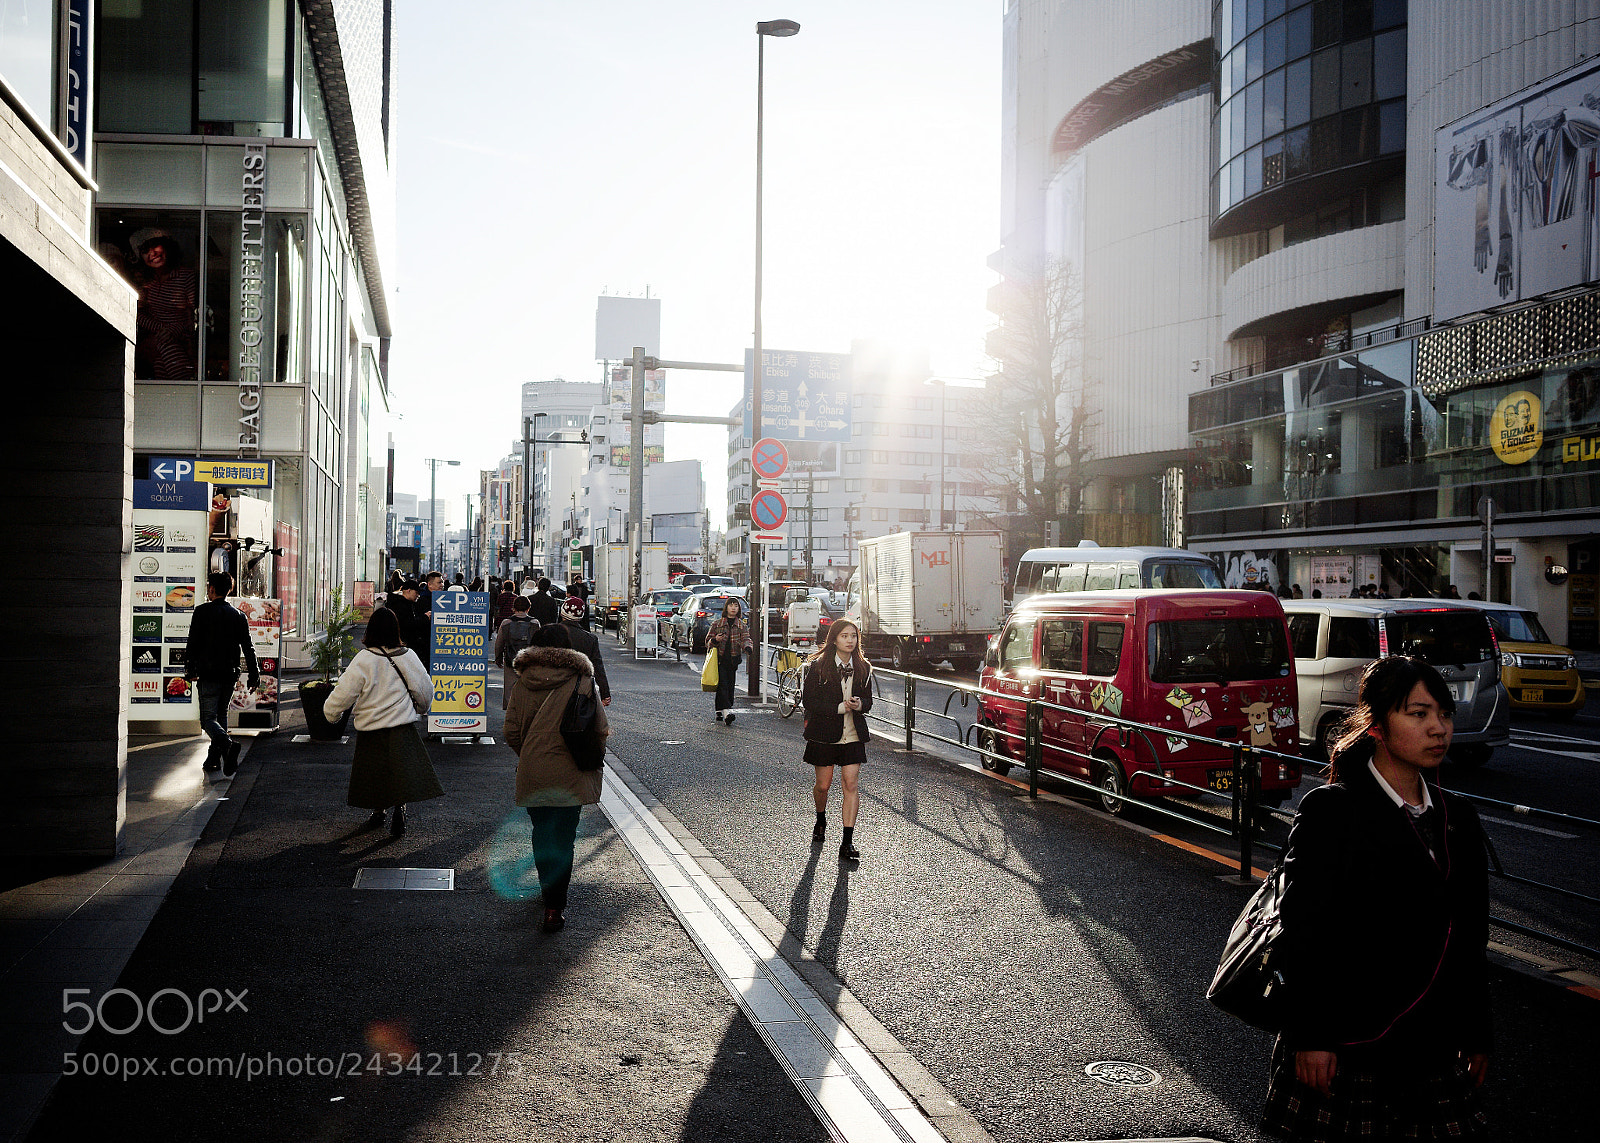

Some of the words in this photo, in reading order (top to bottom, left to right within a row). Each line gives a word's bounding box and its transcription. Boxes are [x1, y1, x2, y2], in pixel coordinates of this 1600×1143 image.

[1056, 101, 1104, 144] LAFORET
[1101, 50, 1198, 96] MUSEUM
[240, 154, 265, 348] OUTFITTERS
[765, 366, 790, 377] Ebisu
[808, 368, 841, 381] Shibuya
[238, 351, 262, 451] EAGLE
[818, 404, 845, 416] Ohara
[776, 417, 788, 426] 413
[1500, 423, 1535, 440] GUZMAN
[1500, 441, 1506, 449] Y
[1506, 434, 1536, 448] GOMEZ
[1562, 436, 1600, 463] GU
[175, 460, 192, 482] P
[198, 466, 266, 481] 一般時間貸
[156, 482, 177, 495] YM
[150, 494, 184, 503] SQUARE
[142, 590, 162, 598] WEGO
[455, 592, 469, 611] P
[436, 613, 483, 625] 一般時間貸
[435, 634, 485, 647] ¥2000
[452, 647, 483, 656] ¥2400
[134, 681, 158, 690] KINJI
[434, 679, 484, 689] ハイルーフ
[433, 690, 457, 702] OK
[1216, 777, 1233, 790] 69-
